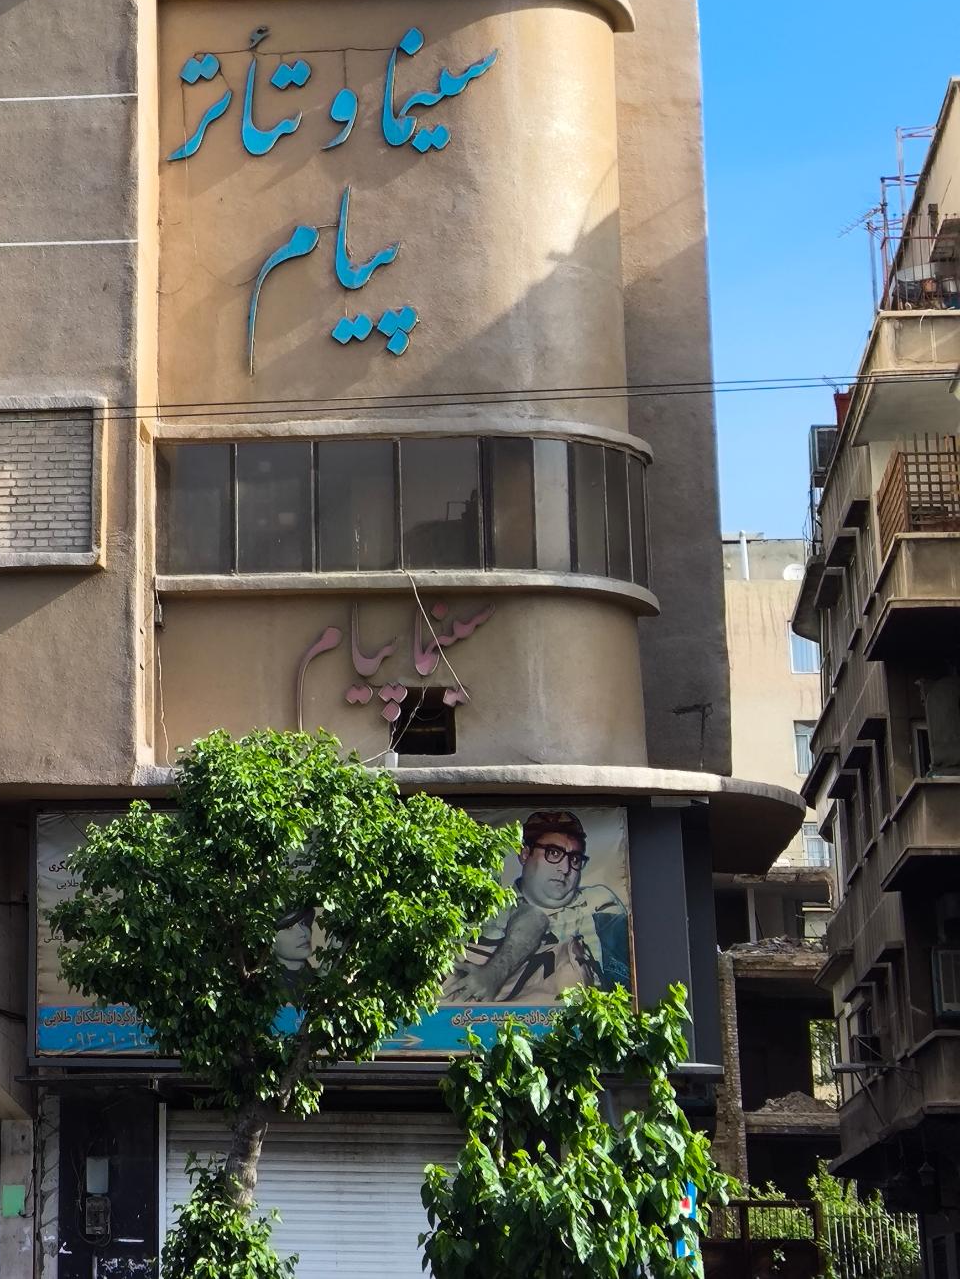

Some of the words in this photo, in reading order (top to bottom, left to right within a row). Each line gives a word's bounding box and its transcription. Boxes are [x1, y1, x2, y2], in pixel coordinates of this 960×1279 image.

[321, 88, 358, 152] و
[382, 26, 499, 153] سینما
[248, 183, 422, 376] پیام
[296, 602, 408, 734] پیام
[413, 601, 496, 707] سینما
